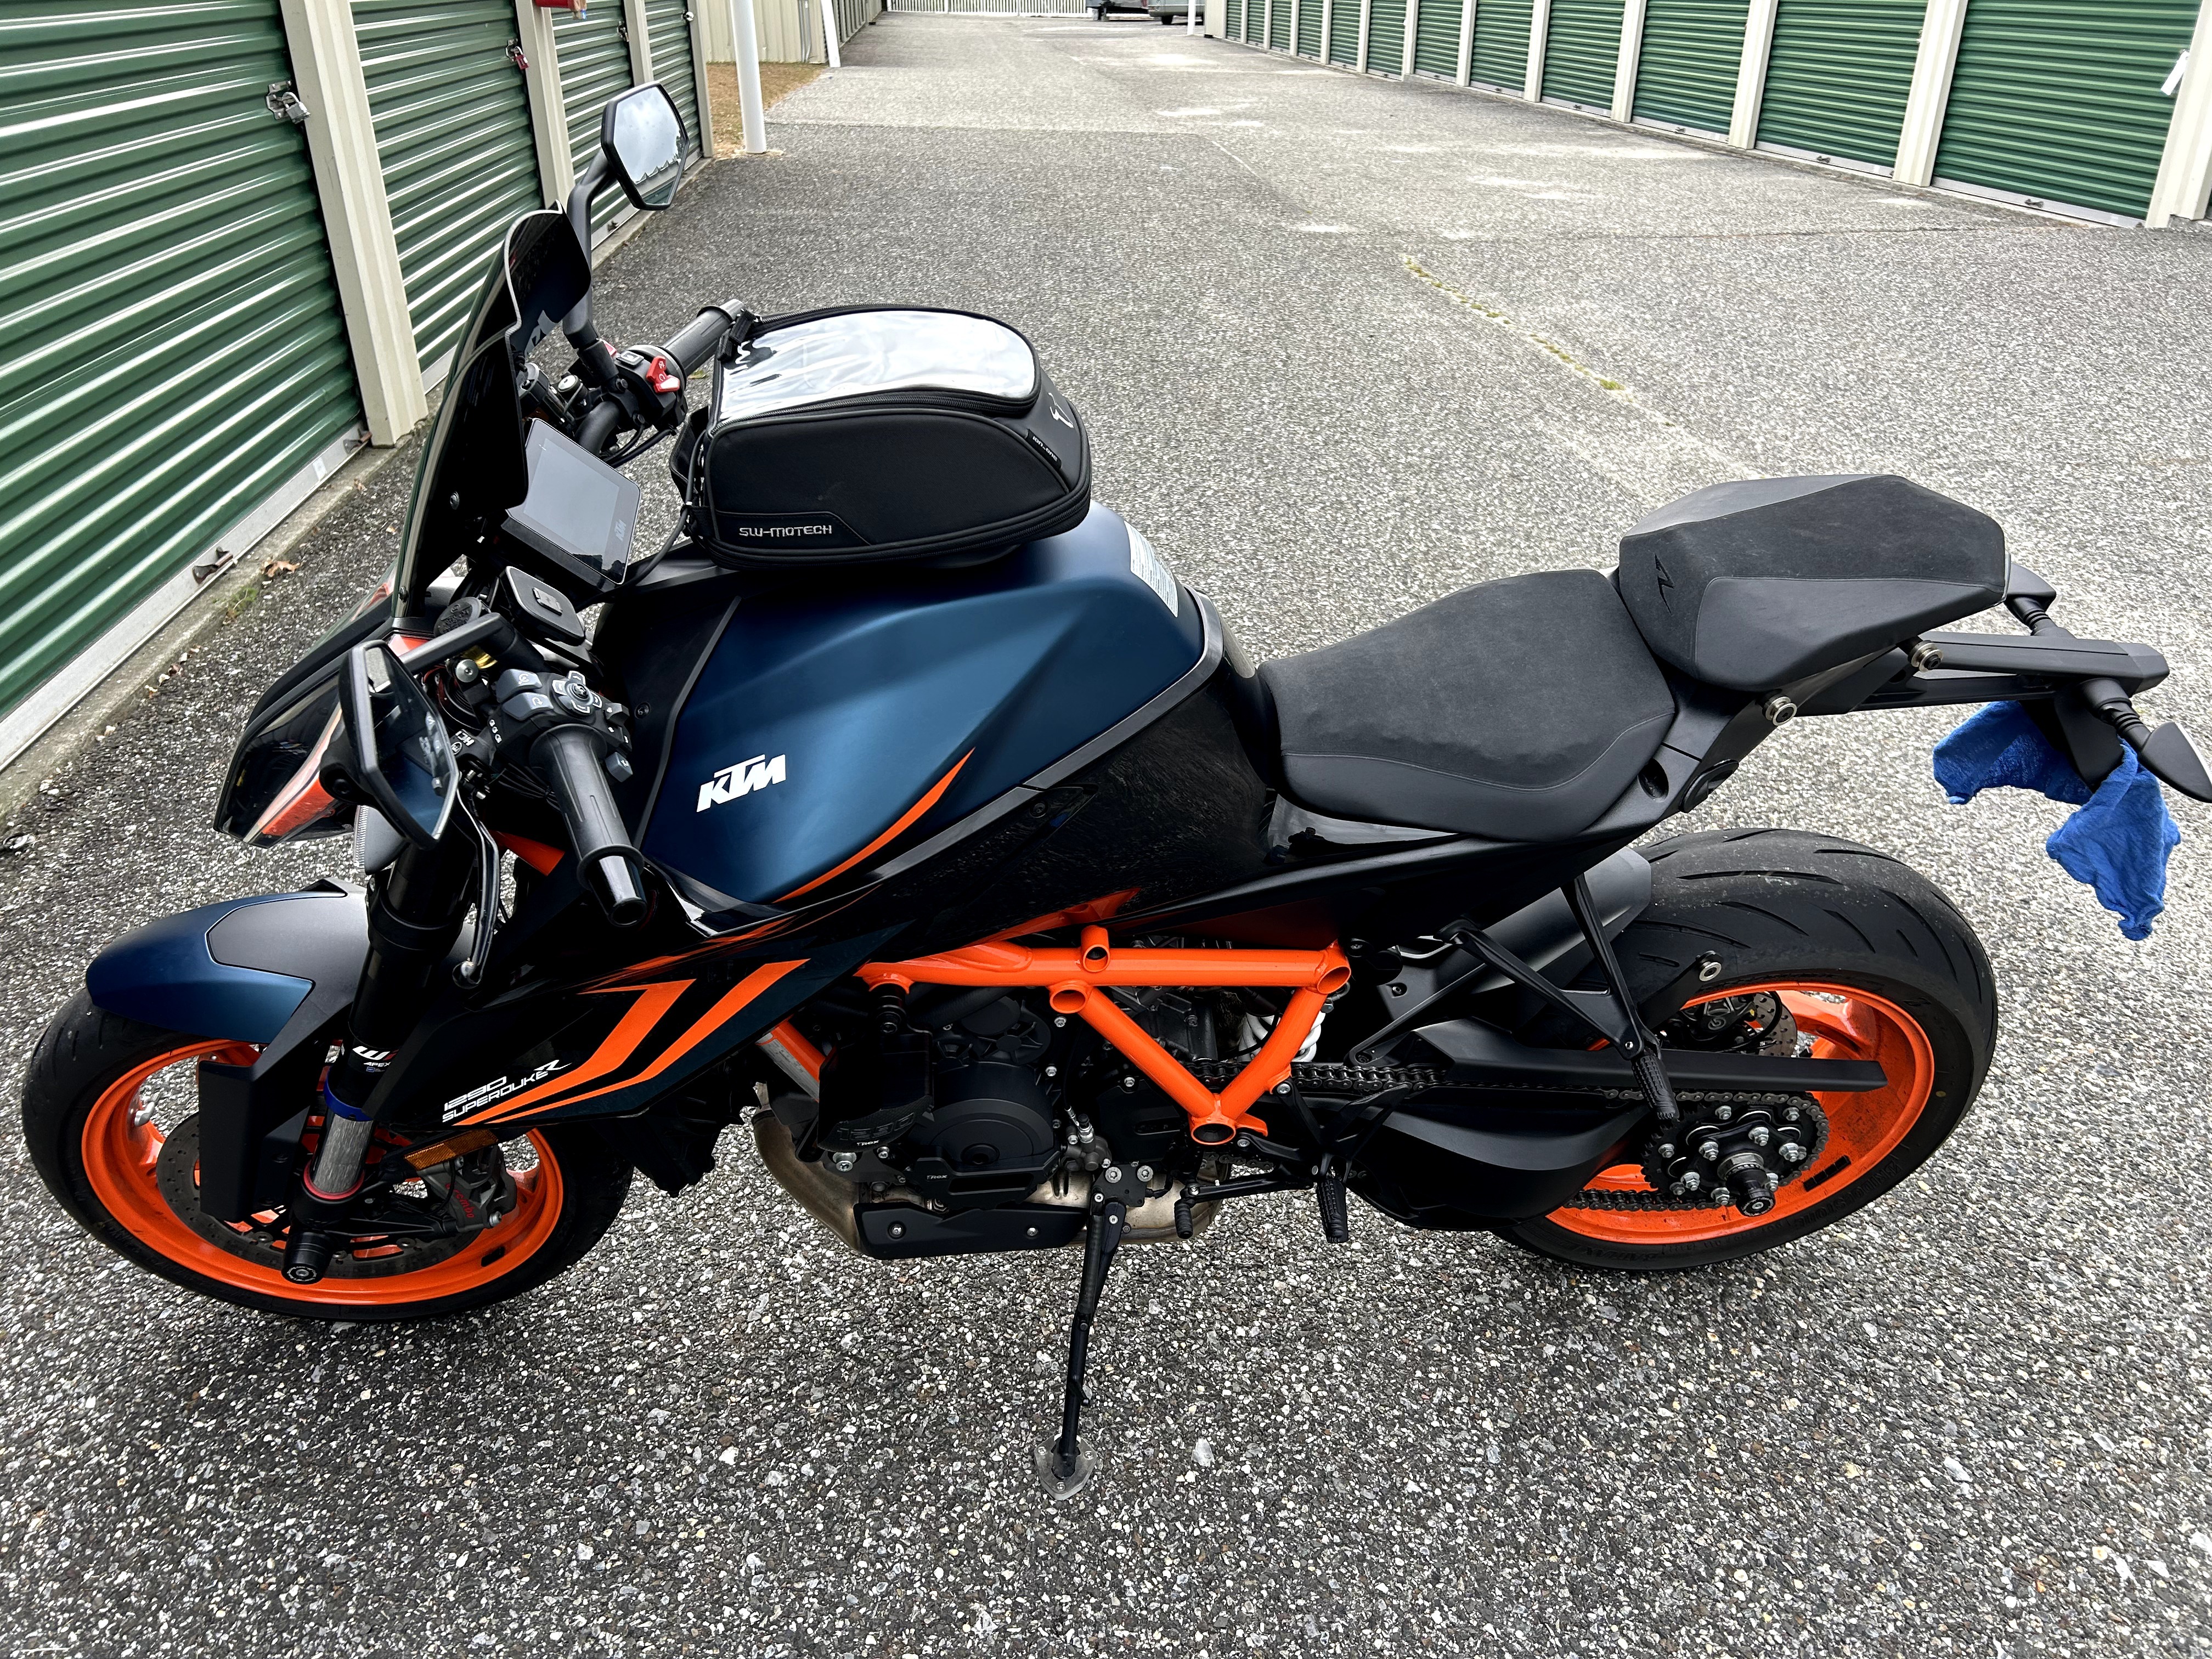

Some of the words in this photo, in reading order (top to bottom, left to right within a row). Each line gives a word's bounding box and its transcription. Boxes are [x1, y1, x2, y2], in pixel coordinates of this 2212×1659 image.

[738, 525, 832, 537] SW-MOTECH
[696, 754, 786, 813] KTM
[442, 1071, 549, 1123] SUPERDUKE
[444, 1076, 507, 1111] 1290
